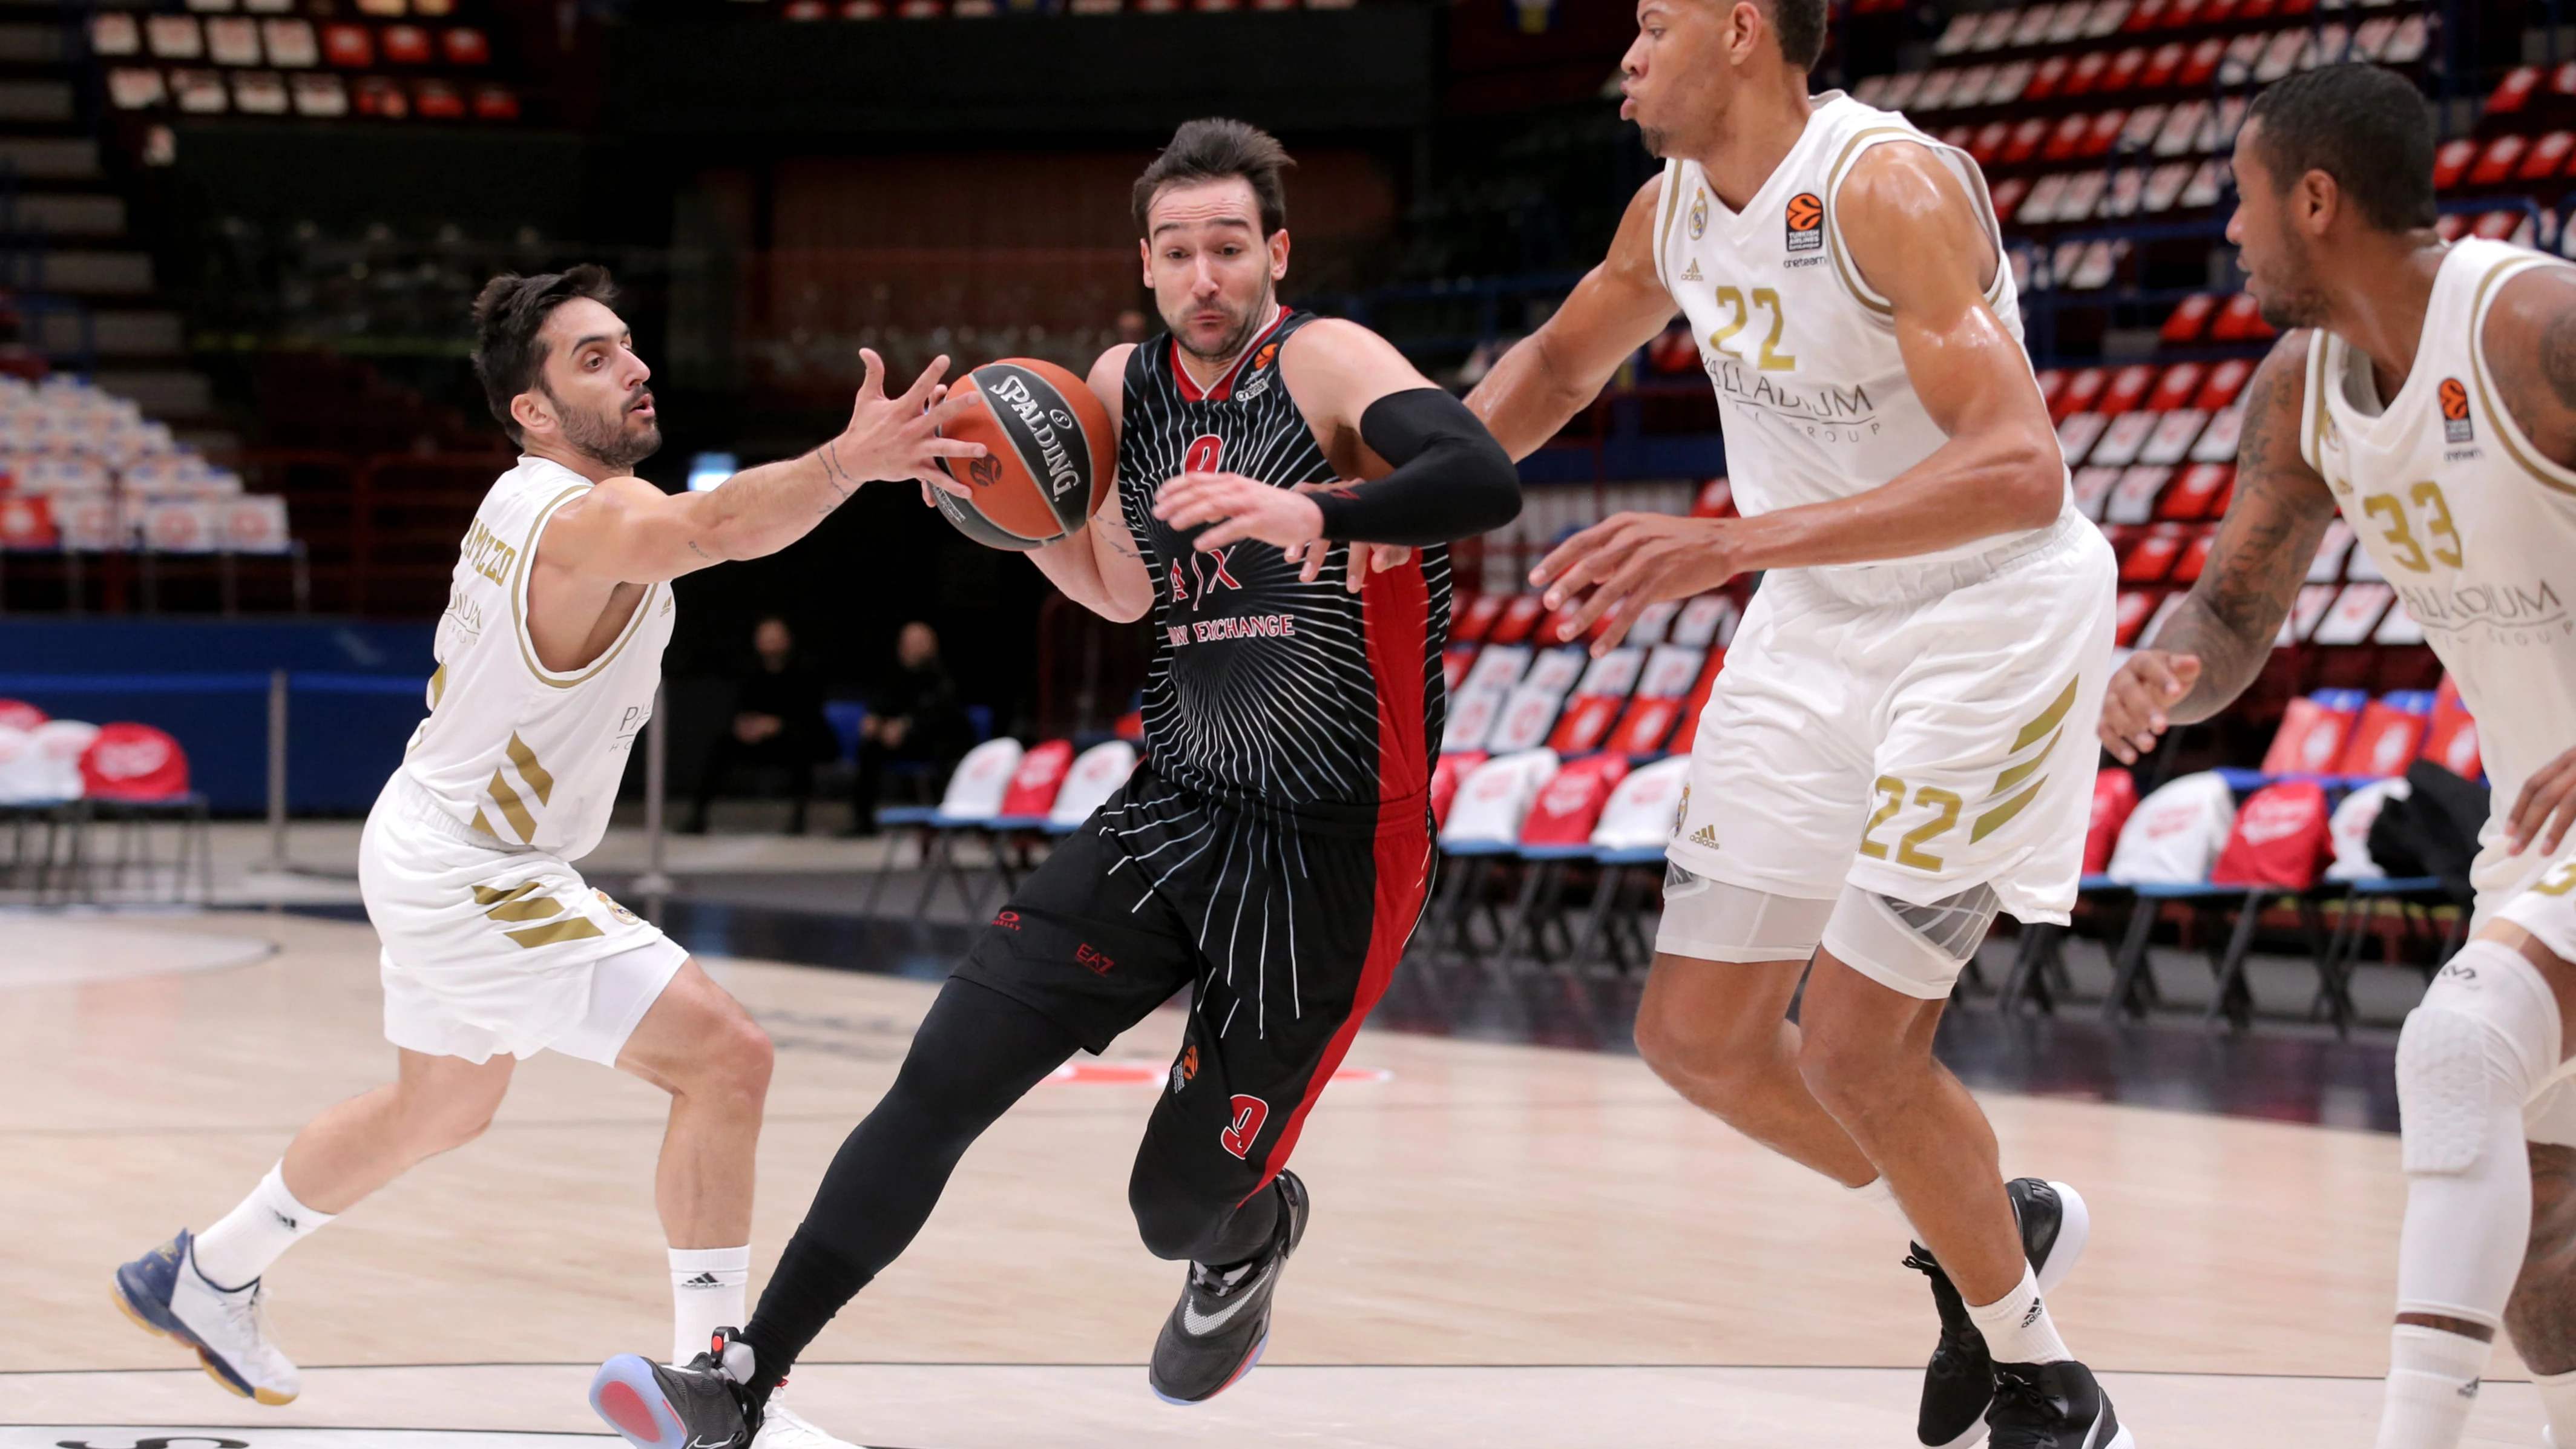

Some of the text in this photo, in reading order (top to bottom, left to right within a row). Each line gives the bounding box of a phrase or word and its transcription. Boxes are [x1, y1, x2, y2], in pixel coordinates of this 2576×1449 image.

[1709, 286, 1796, 371] 22
[988, 375, 1082, 498] SPALDING
[2363, 481, 2463, 573] 33
[1192, 614, 1295, 642] EXCHANGE
[1689, 835, 1720, 850] adidas
[1858, 774, 1963, 873] 22
[1076, 943, 1115, 973] EA7
[1220, 1094, 1269, 1160] 9
